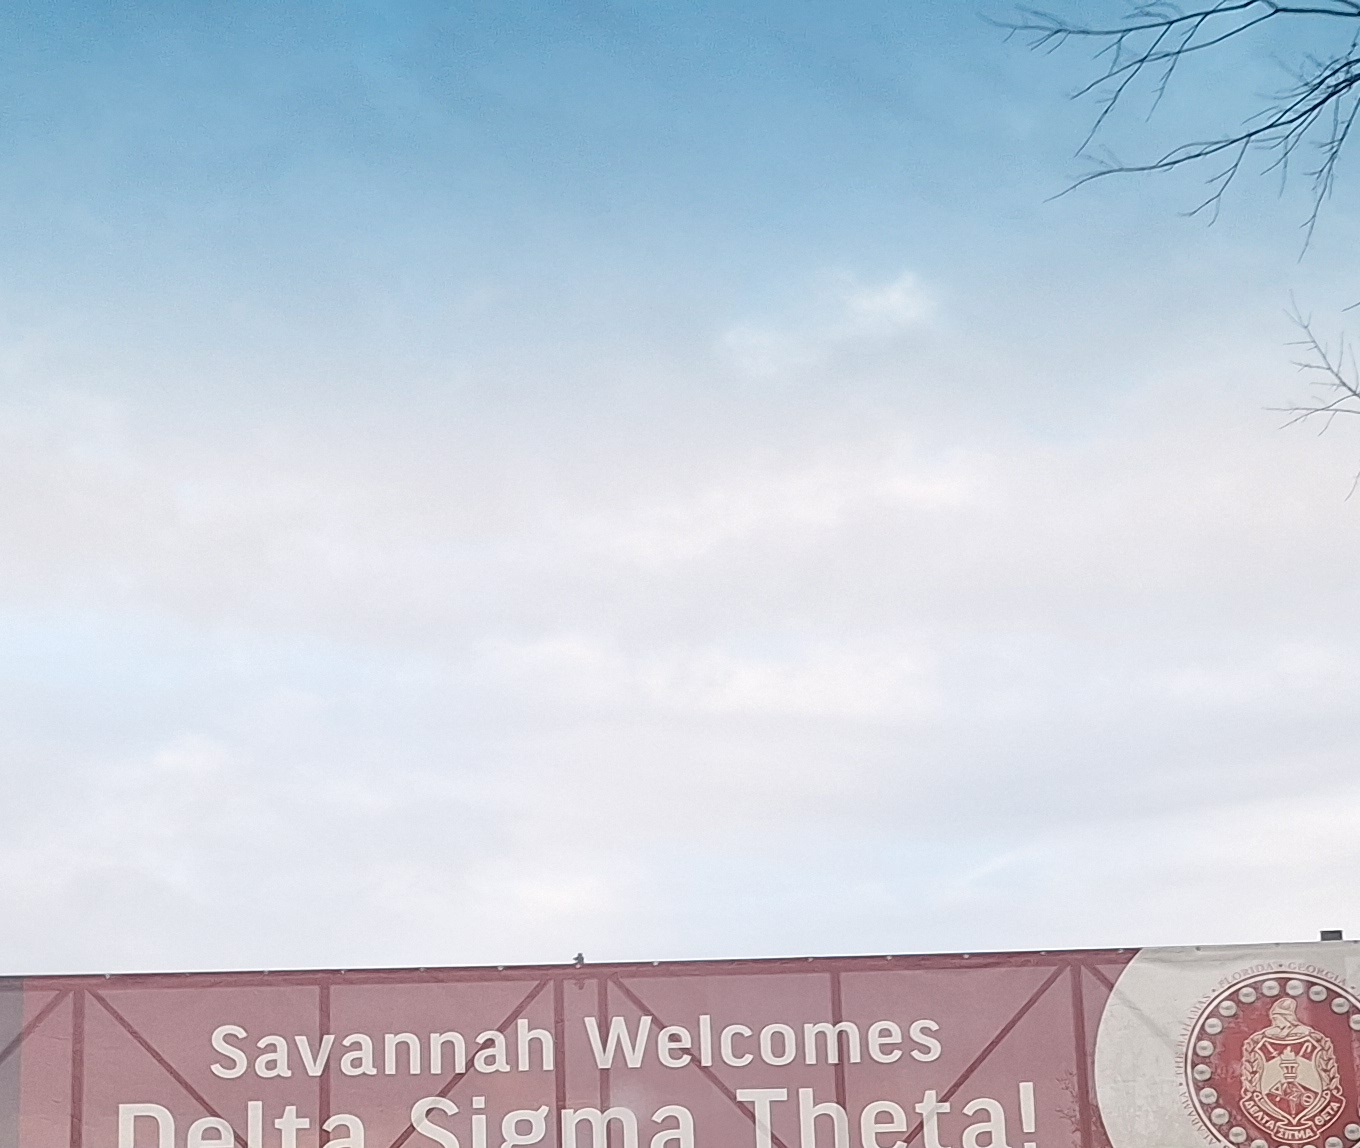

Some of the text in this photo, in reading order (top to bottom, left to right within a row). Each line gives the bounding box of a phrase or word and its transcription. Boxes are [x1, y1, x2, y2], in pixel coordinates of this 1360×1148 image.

[1218, 962, 1275, 991] FLORIDA
[1287, 961, 1348, 987] GEORGIA
[209, 1014, 943, 1080] Savannah Welcomes
